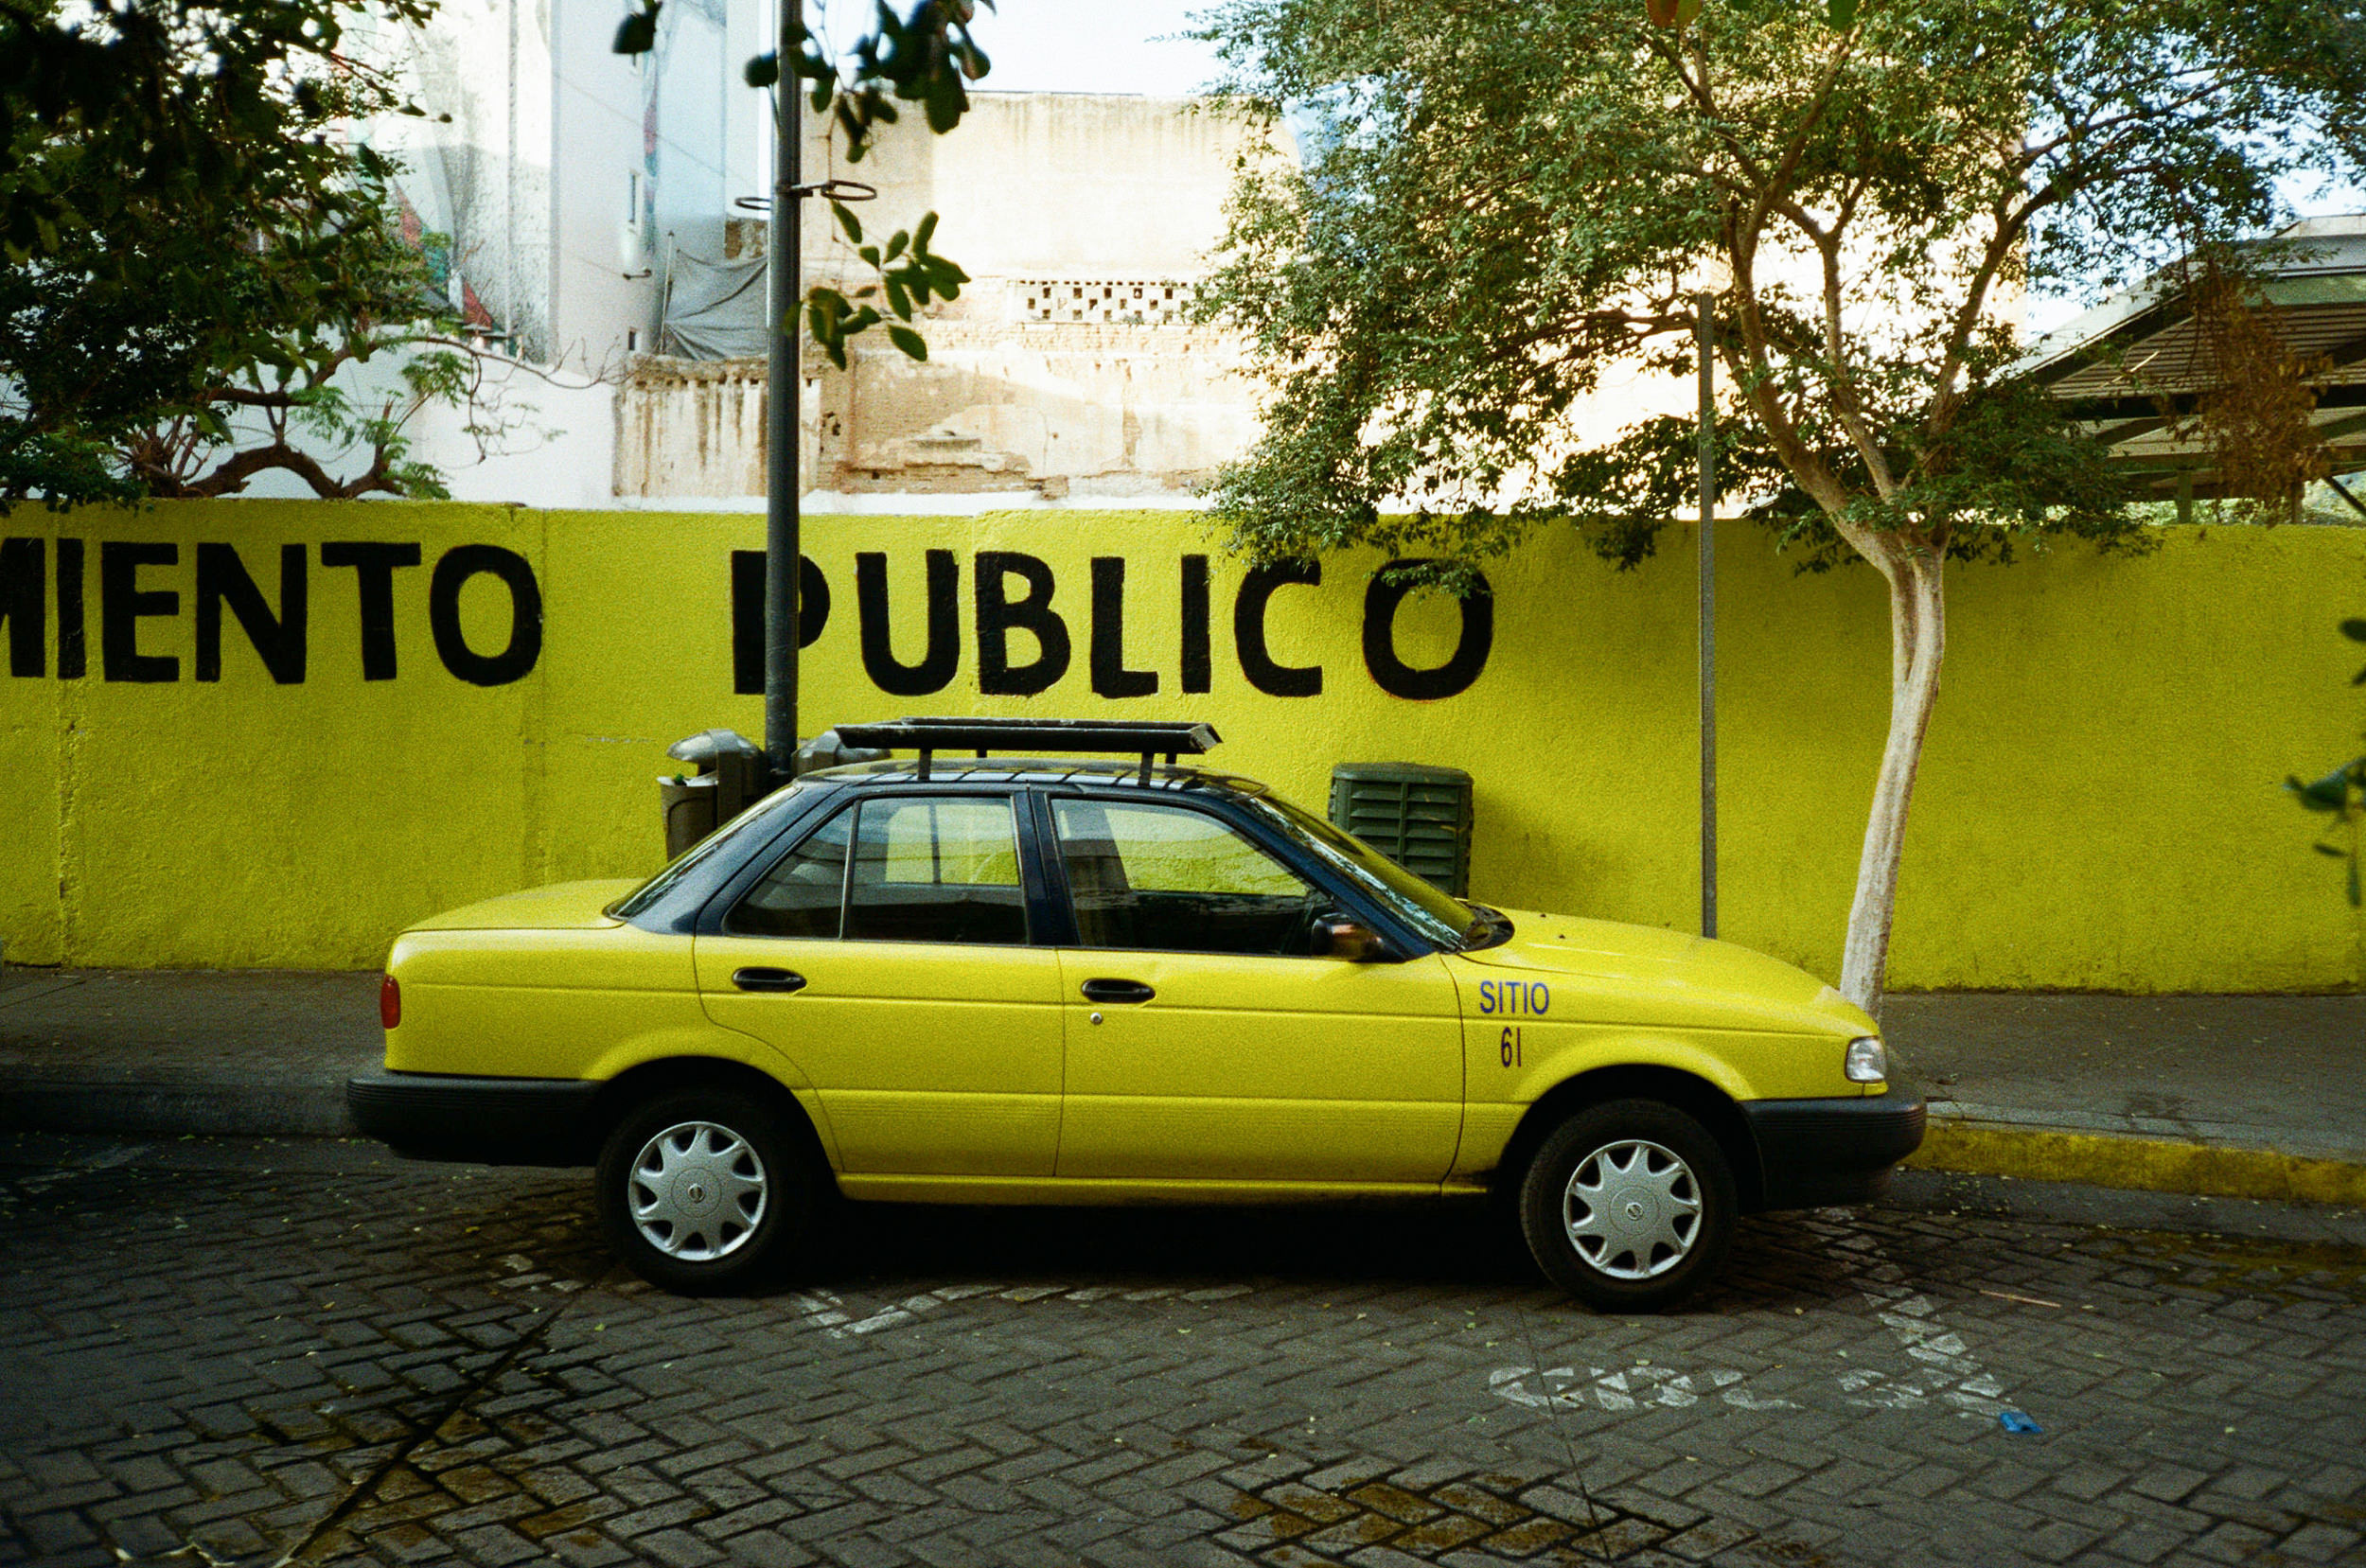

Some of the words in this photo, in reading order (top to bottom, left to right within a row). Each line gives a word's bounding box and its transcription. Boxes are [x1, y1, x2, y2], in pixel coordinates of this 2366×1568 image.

[732, 549, 1494, 701] PUBLICO
[1479, 980, 1550, 1015] SITIO
[1500, 1026, 1522, 1068] 61
